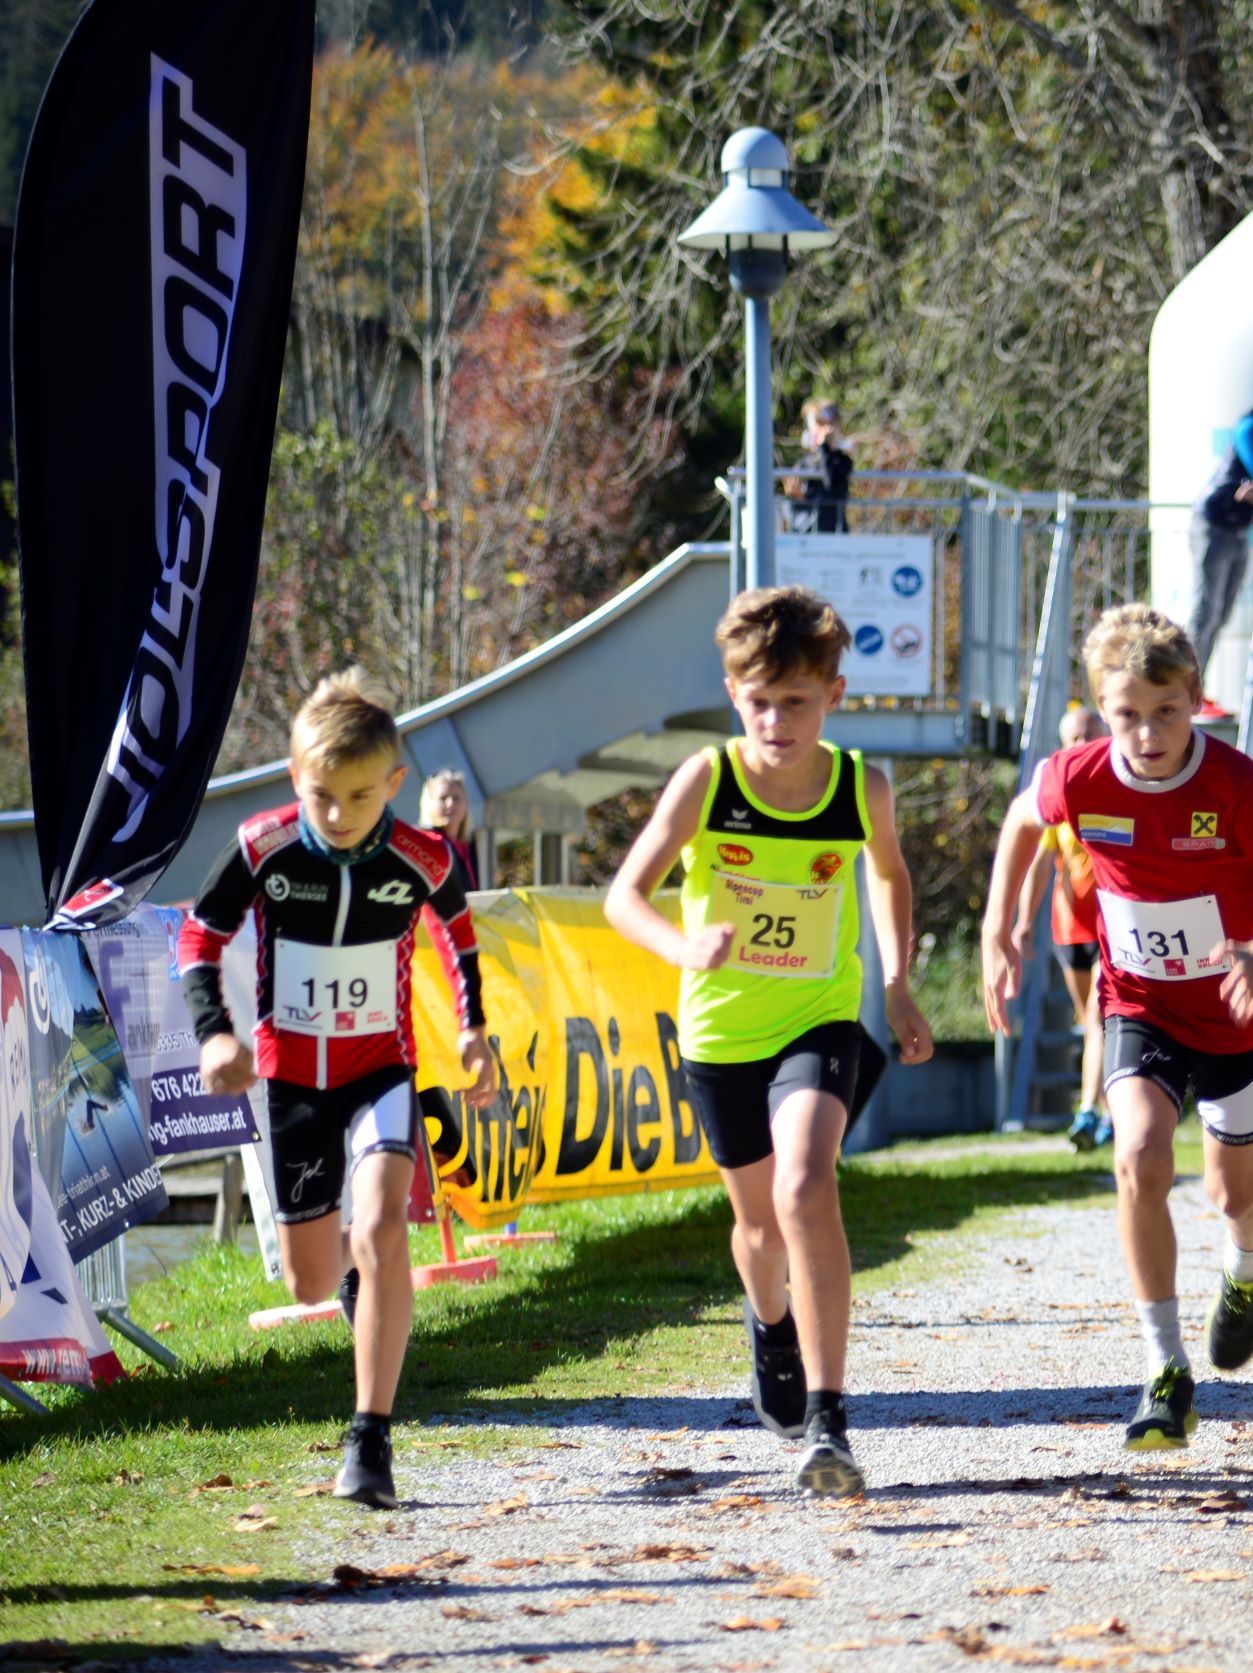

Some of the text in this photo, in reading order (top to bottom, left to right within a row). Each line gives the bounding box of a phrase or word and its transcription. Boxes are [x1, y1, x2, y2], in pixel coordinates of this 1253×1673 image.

[108, 53, 247, 843] JOLSPORT
[749, 913, 797, 949] 25
[1128, 928, 1190, 957] 131
[739, 945, 808, 968] Leader
[282, 1004, 322, 1021] TLV
[302, 978, 368, 1009] 119
[555, 1016, 662, 1176] Die
[148, 1106, 247, 1146] ng-fankhauser.at
[57, 1165, 112, 1208] ee-triathlon.at
[76, 1194, 115, 1232] KURZ-
[112, 1187, 126, 1209] &
